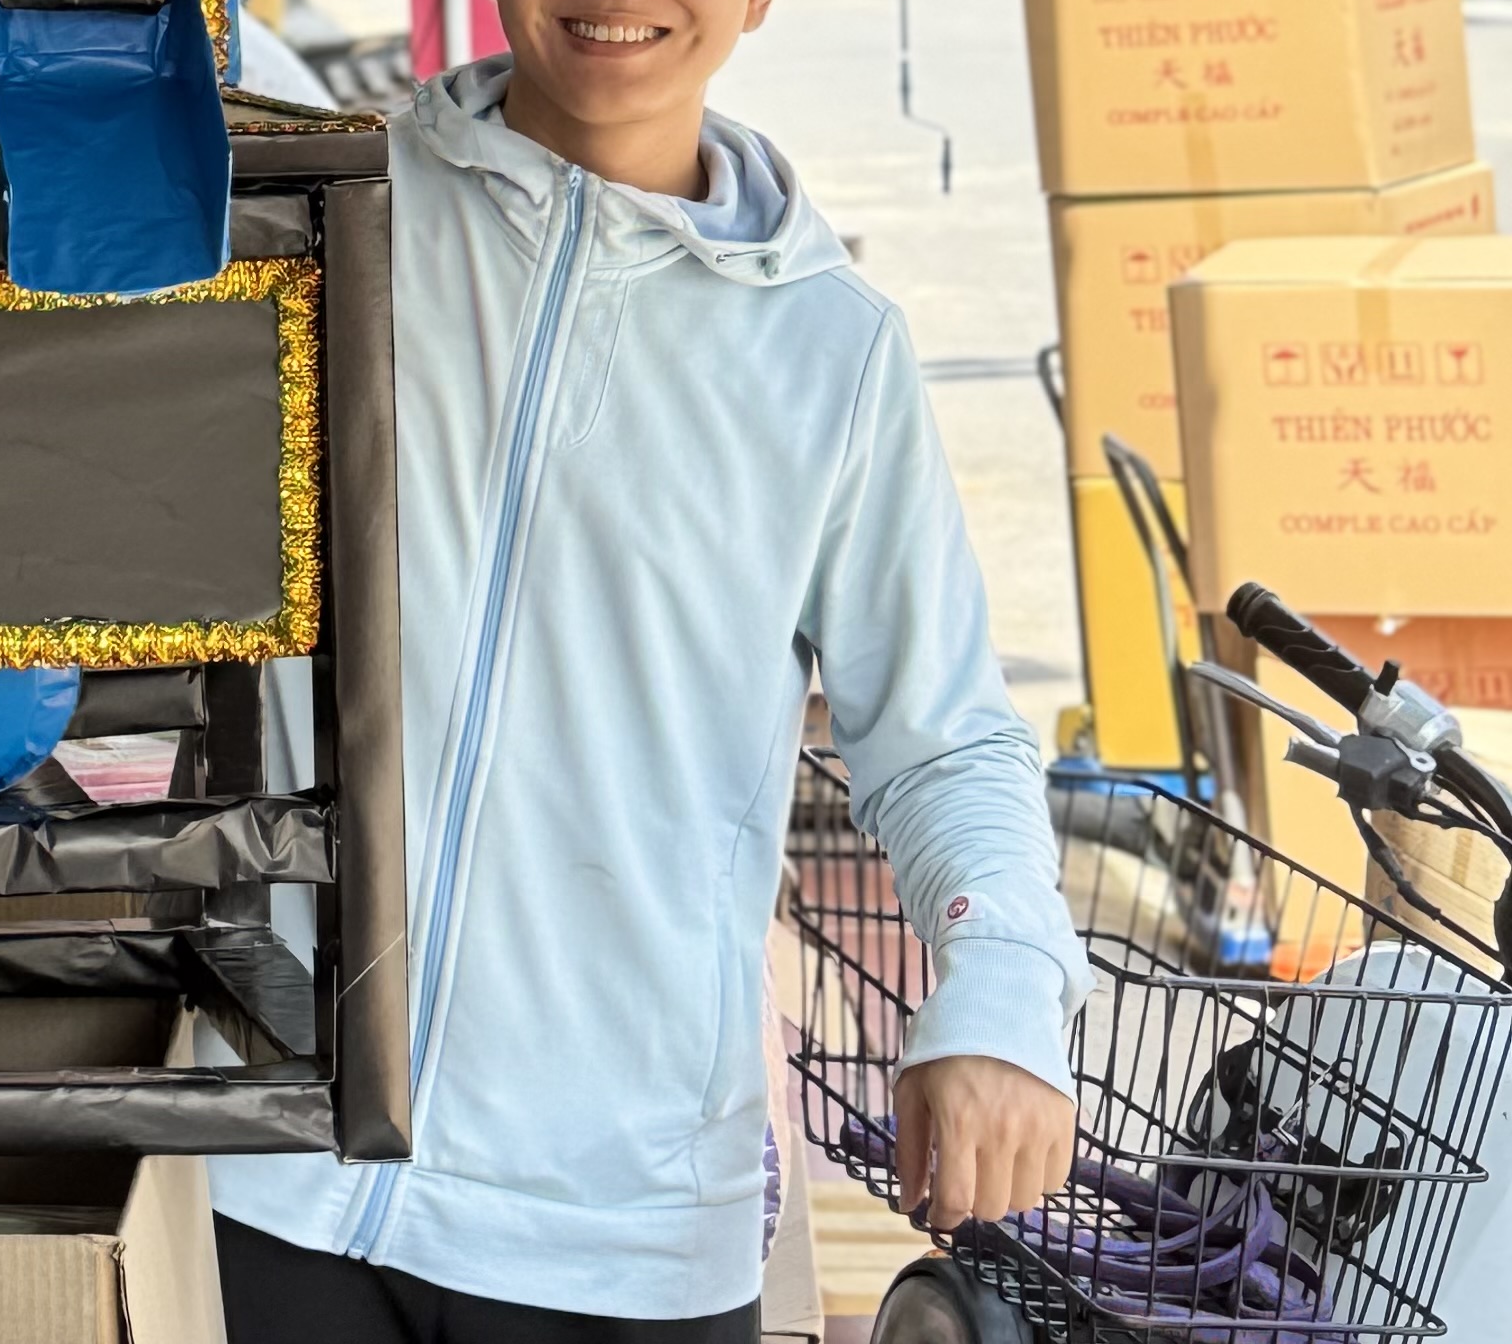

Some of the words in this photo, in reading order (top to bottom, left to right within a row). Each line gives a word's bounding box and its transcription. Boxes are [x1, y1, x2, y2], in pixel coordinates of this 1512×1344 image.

[1271, 407, 1373, 444] THIÊN
[1338, 458, 1436, 495] 天福
[1280, 514, 1384, 535] COMPLE
[1388, 514, 1441, 535] CAO
